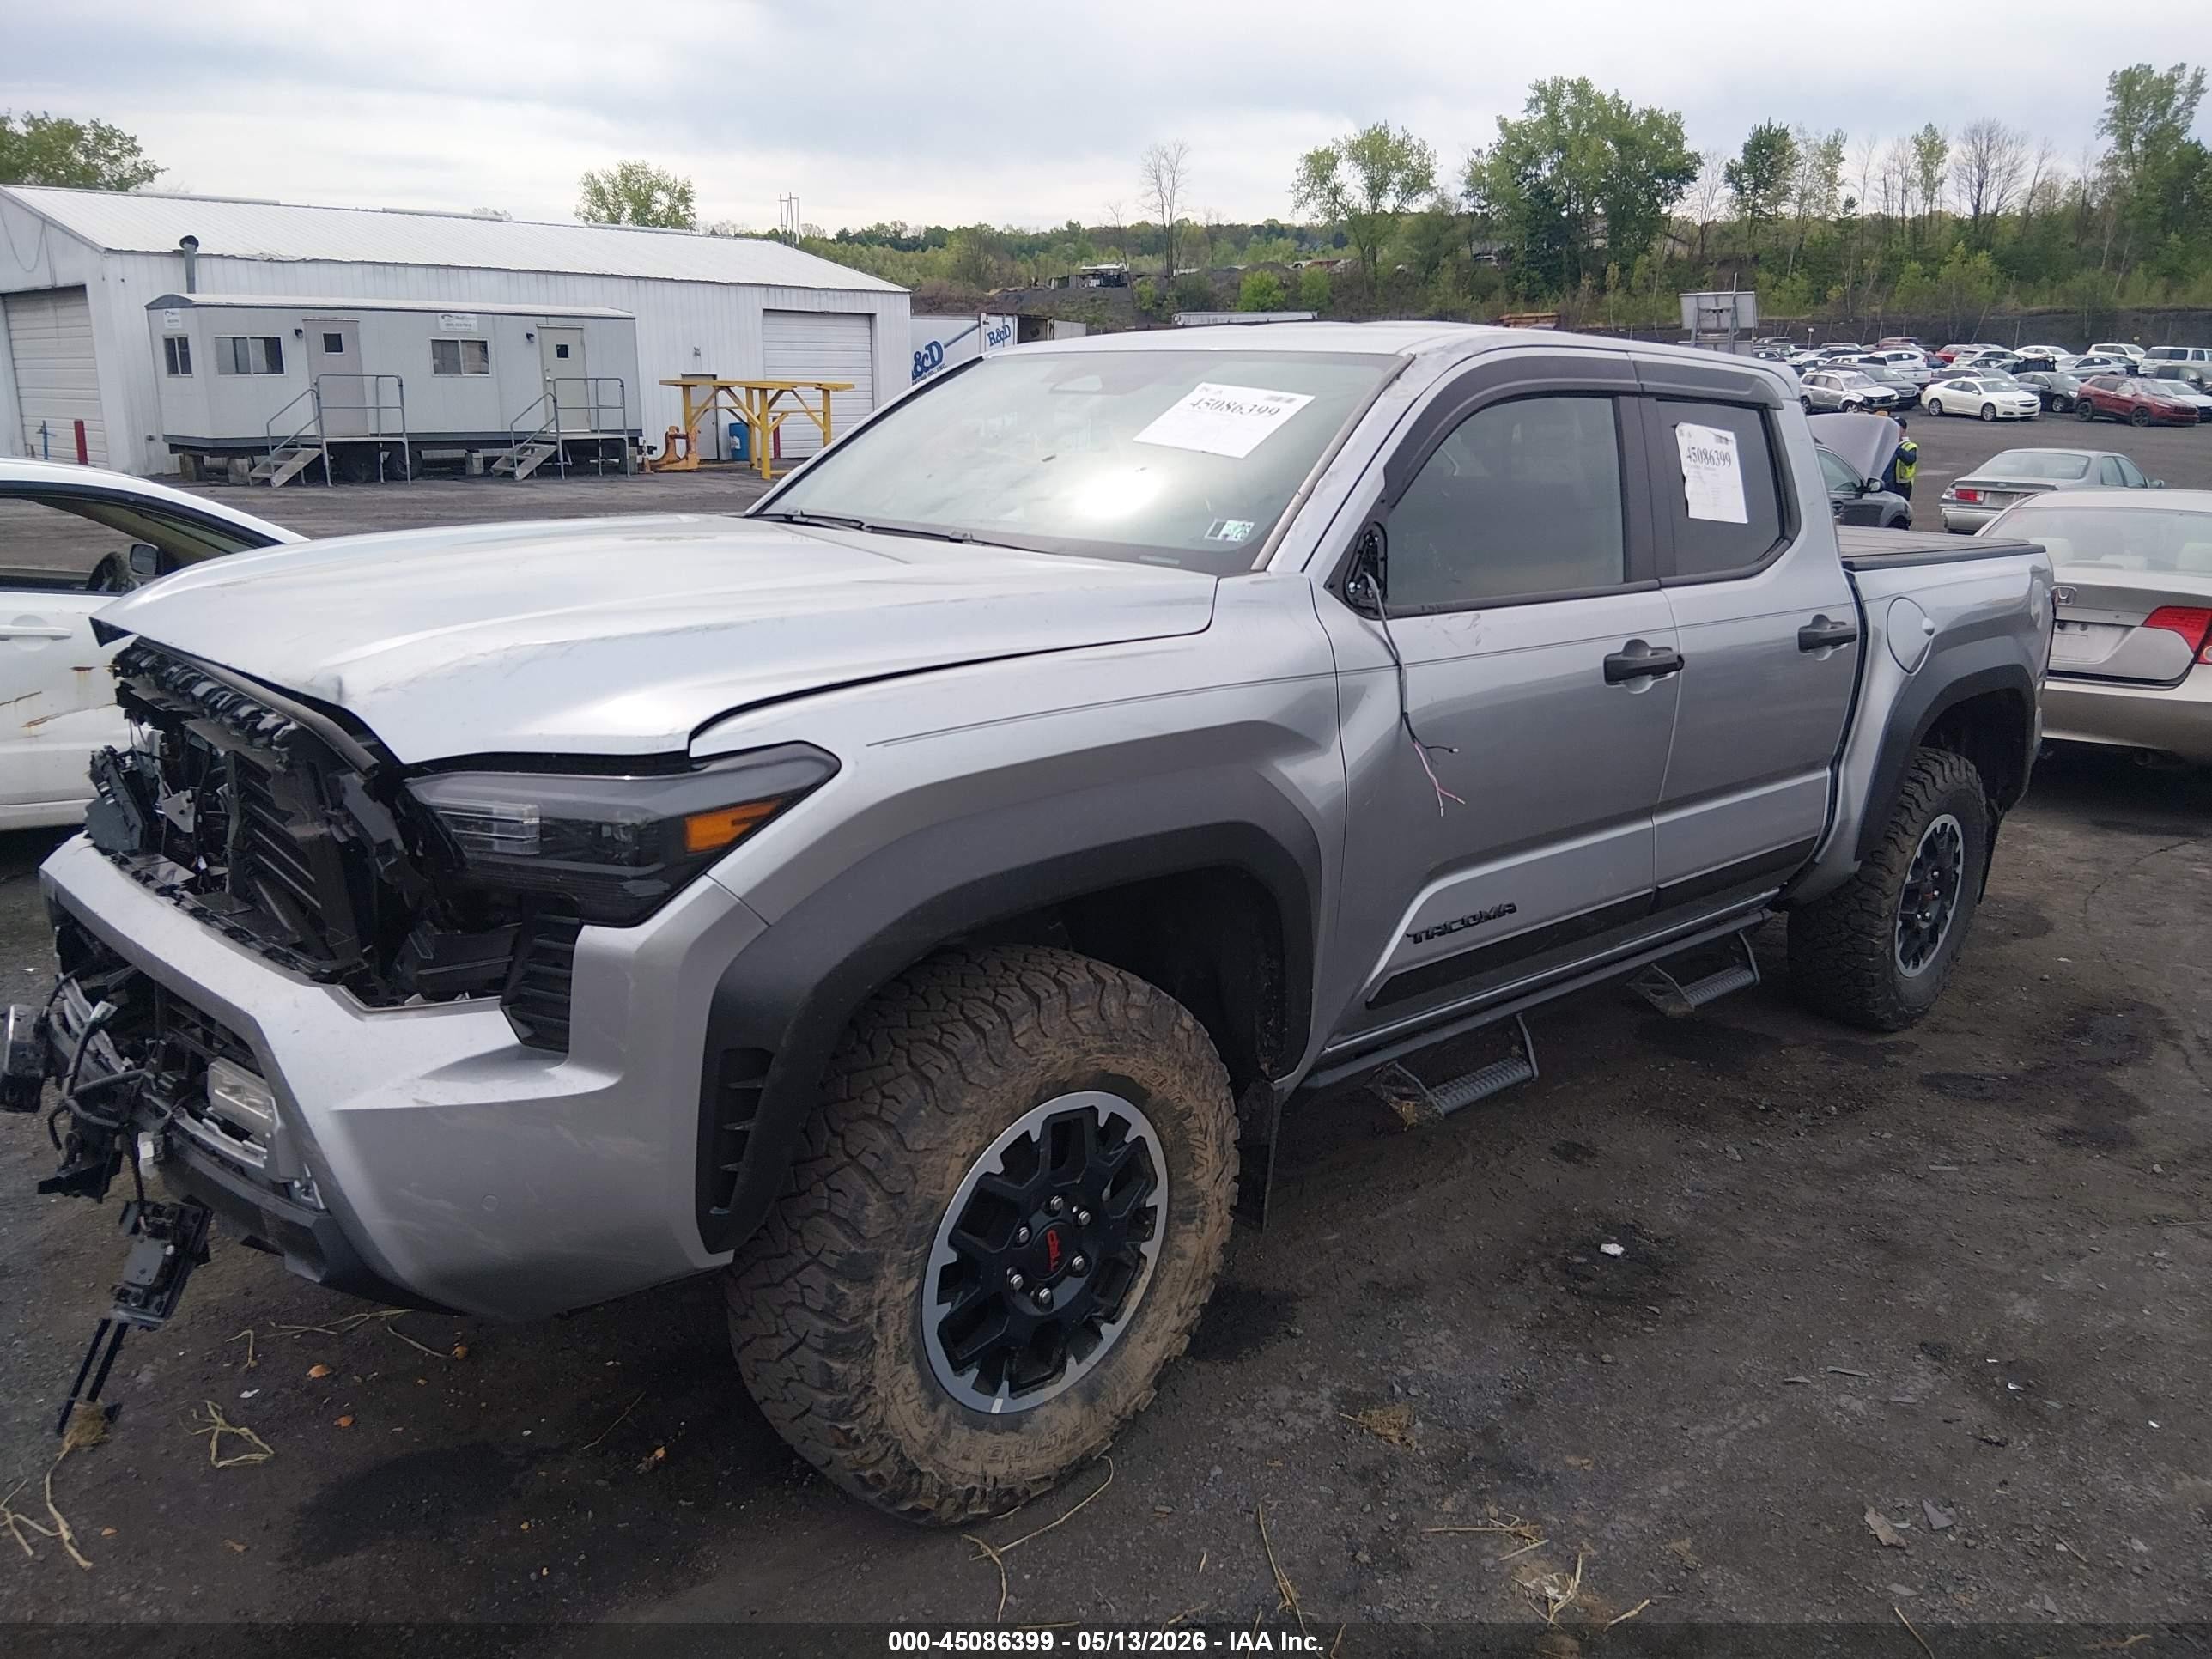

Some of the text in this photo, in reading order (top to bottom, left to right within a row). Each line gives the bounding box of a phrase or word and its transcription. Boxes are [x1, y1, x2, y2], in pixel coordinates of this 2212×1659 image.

[987, 324, 1012, 347] R&D
[1189, 398, 1280, 418] 45086399
[1686, 446, 1731, 468] 45086399
[1406, 902, 1517, 944] TACOMA
